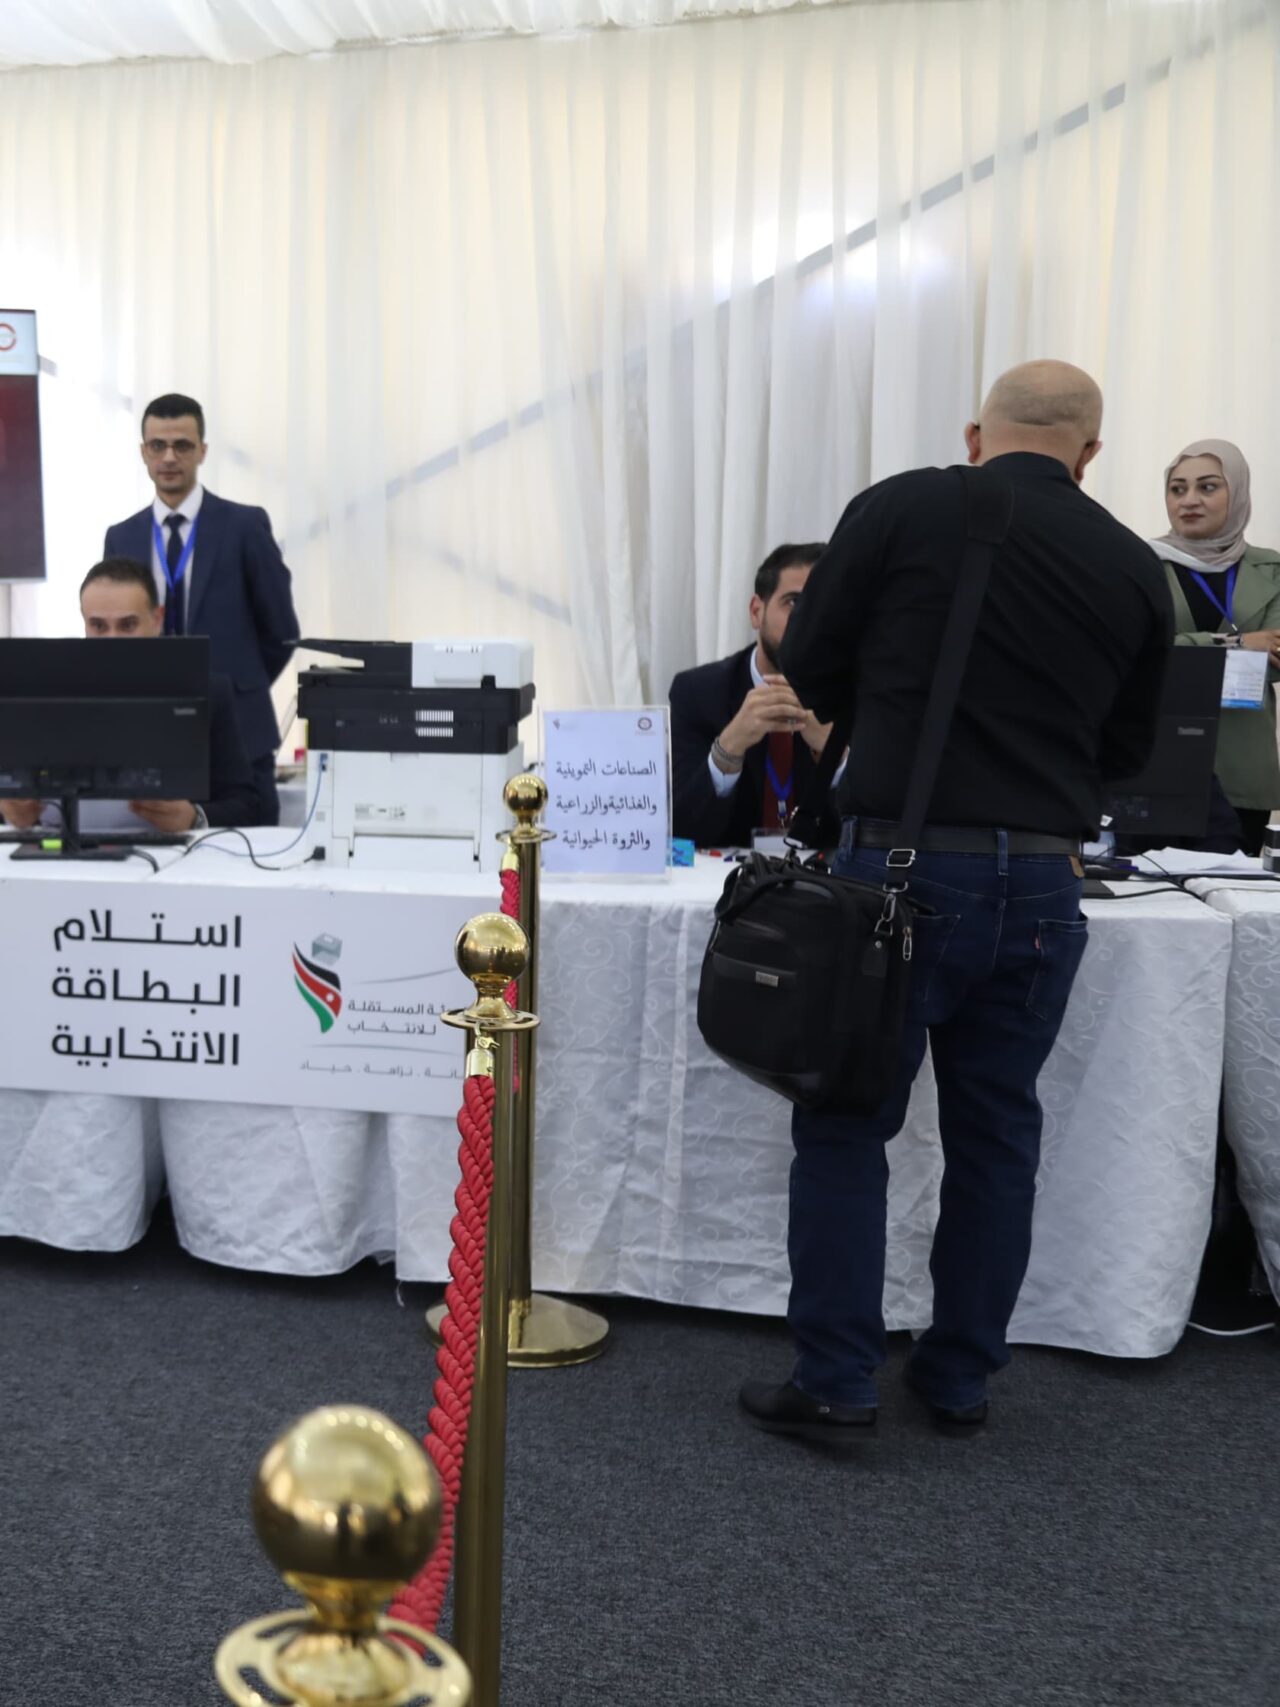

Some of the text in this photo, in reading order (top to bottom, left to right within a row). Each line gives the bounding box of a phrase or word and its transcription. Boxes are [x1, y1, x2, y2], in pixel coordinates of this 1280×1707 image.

[556, 759, 656, 780] الصناعات التموينية
[562, 829, 650, 850] والثروة الحيوانية
[54, 909, 241, 951] استلام
[52, 967, 240, 1014] البطاقة
[348, 1000, 425, 1016] المستقلة
[347, 1019, 436, 1036] للانتخاب
[52, 1025, 239, 1067] الانتخابية
